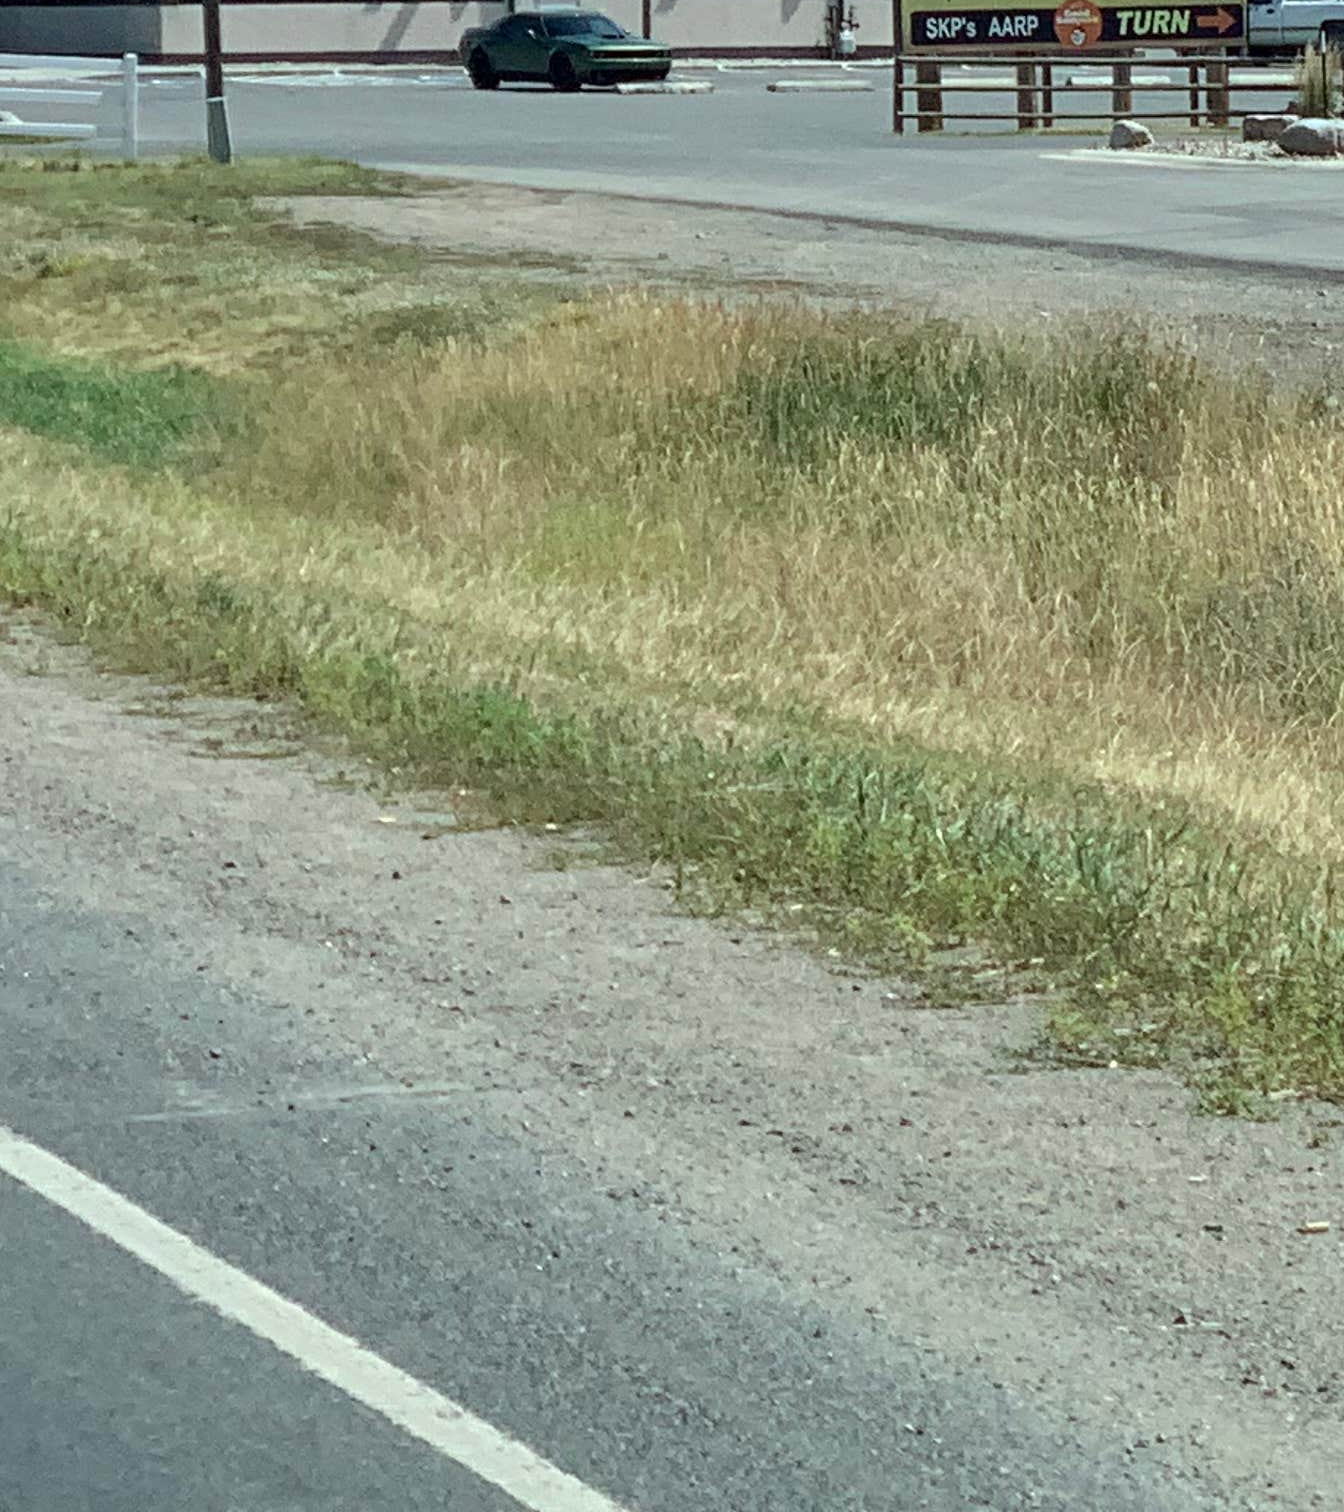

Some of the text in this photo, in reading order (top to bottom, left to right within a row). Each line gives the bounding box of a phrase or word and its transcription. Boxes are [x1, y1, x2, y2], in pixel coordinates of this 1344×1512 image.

[925, 9, 1191, 40] SKP's AARP TURN
